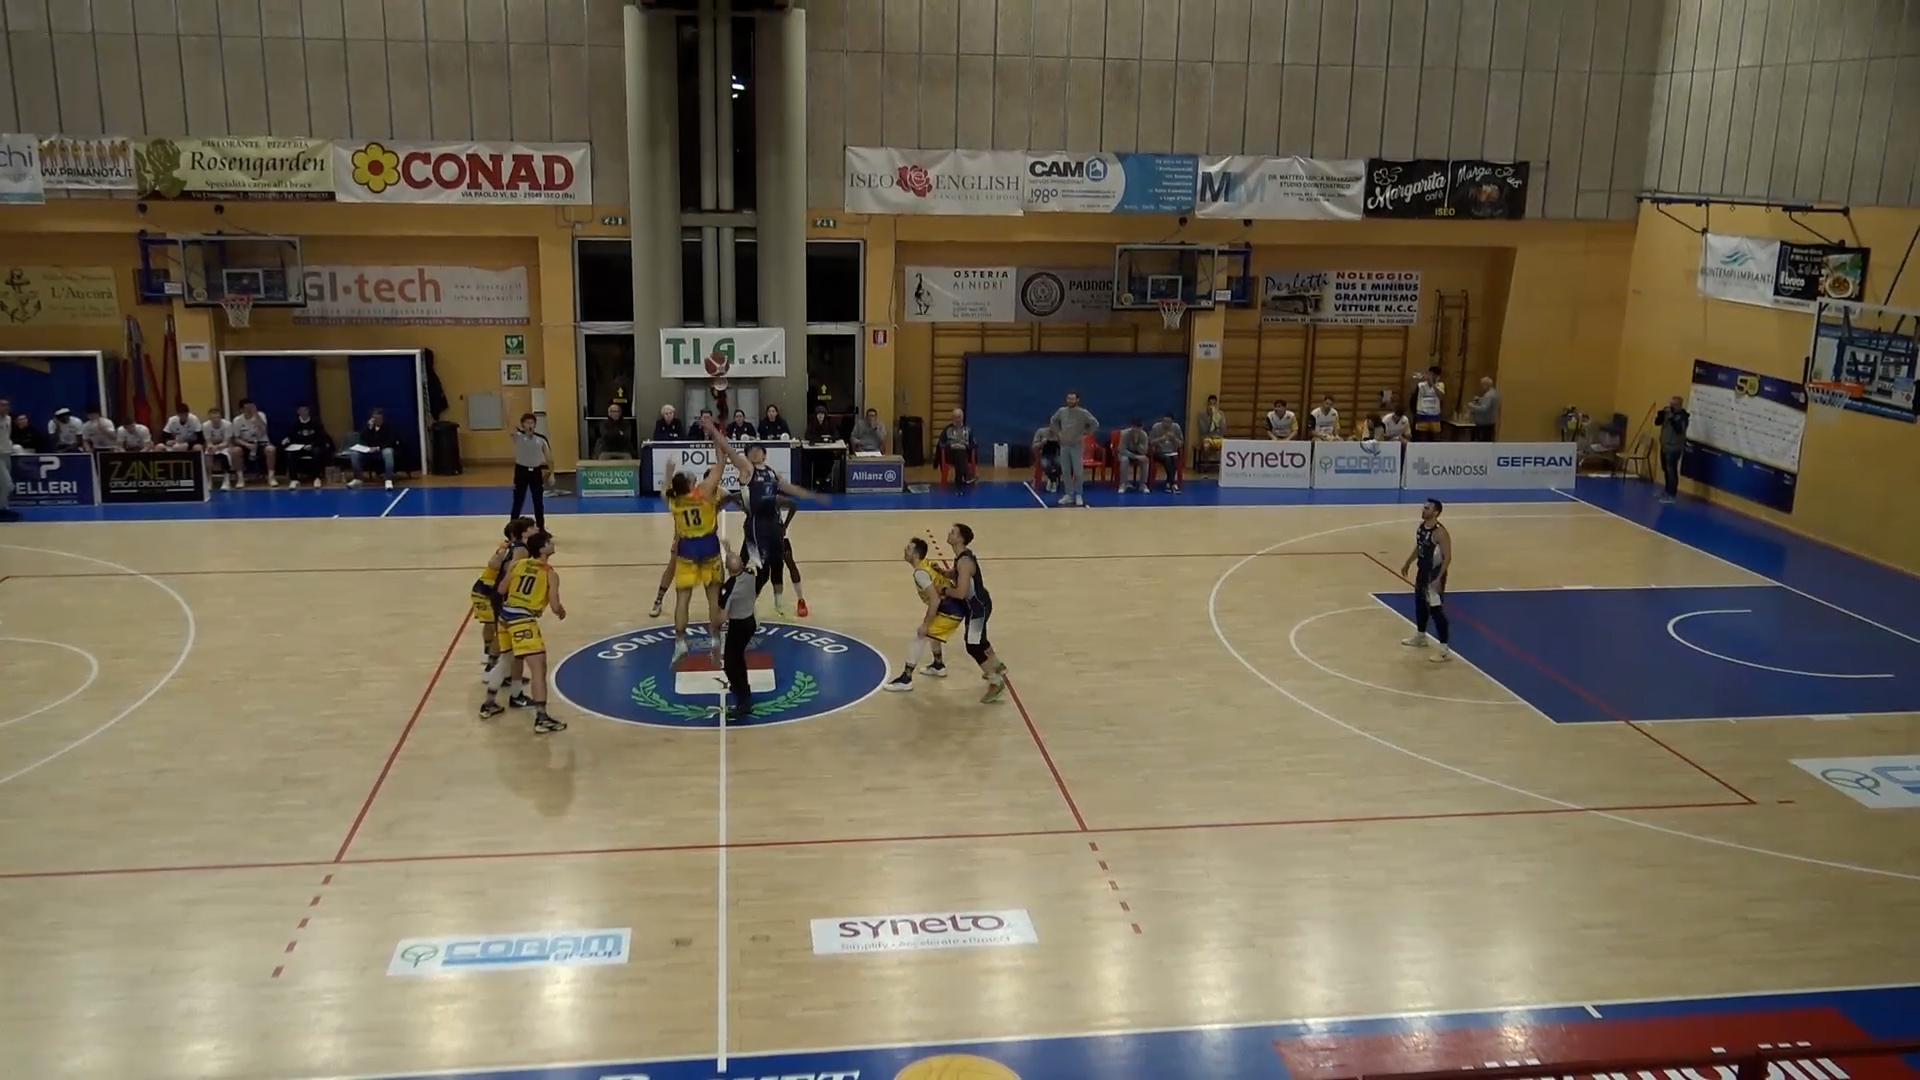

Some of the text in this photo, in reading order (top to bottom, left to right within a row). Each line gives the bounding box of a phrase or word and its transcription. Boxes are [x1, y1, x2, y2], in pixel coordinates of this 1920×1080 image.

[266, 140, 309, 149] PIZZERIA
[191, 150, 325, 181] Rosengarden
[401, 150, 575, 191] CONAD
[1029, 160, 1084, 178] CAM
[849, 172, 1020, 191] ISEO ENGLISH
[1367, 171, 1447, 210] Margarita
[1434, 207, 1456, 217] ISEO
[953, 270, 1009, 279] OSTERIA
[1336, 271, 1419, 281] NOLEGGIO:
[953, 281, 1003, 290] AI NIDRI
[1264, 272, 1330, 295] Perletti
[1335, 282, 1419, 292] BUS E MINIBUS
[1334, 292, 1418, 301] GRANTURISMO
[1334, 303, 1417, 313] VETTURE N.C.C.
[751, 351, 782, 366] s.r.l.
[1225, 450, 1307, 470] syneto
[1496, 456, 1573, 468] GEFRAN
[109, 460, 194, 481] ZANETTI
[852, 469, 883, 481] Allianz
[1431, 465, 1488, 477] GANDOSSI
[15, 481, 78, 495] ELLERI
[682, 508, 702, 527] 13
[515, 574, 537, 596] 10
[597, 621, 727, 660] COMUN
[783, 630, 849, 653] ISEO
[839, 914, 1005, 940] syneto
